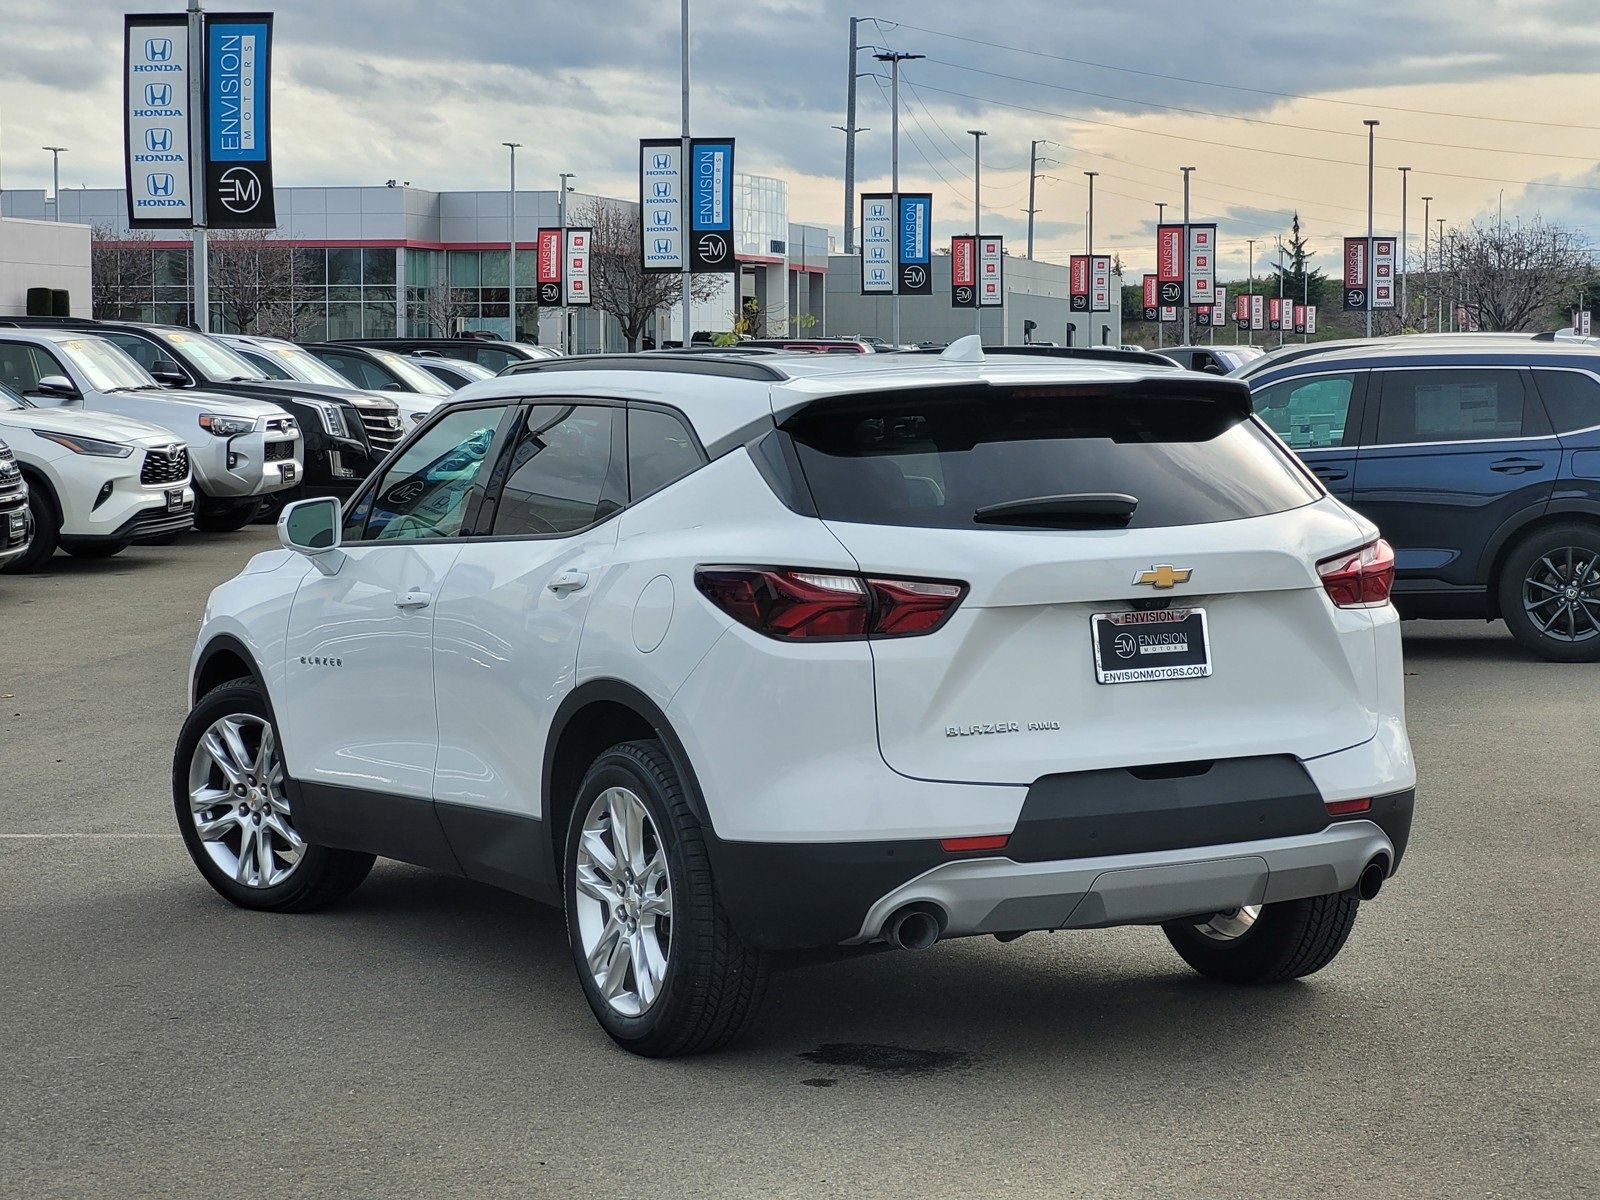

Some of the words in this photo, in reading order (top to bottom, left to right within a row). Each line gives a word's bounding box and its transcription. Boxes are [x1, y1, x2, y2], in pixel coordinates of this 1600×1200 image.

[220, 35, 240, 150] ENVISION
[244, 45, 252, 140] MOTORS
[700, 151, 713, 224] ENVISION
[906, 203, 916, 258] ENVISION
[1124, 611, 1174, 624] ENVISION
[1138, 633, 1188, 646] ENVISION
[300, 656, 342, 668] BLAZER
[1104, 666, 1208, 682] ENVISIONMOTORS.COM
[946, 722, 1019, 737] BLAZER
[1028, 720, 1060, 731] AWD
